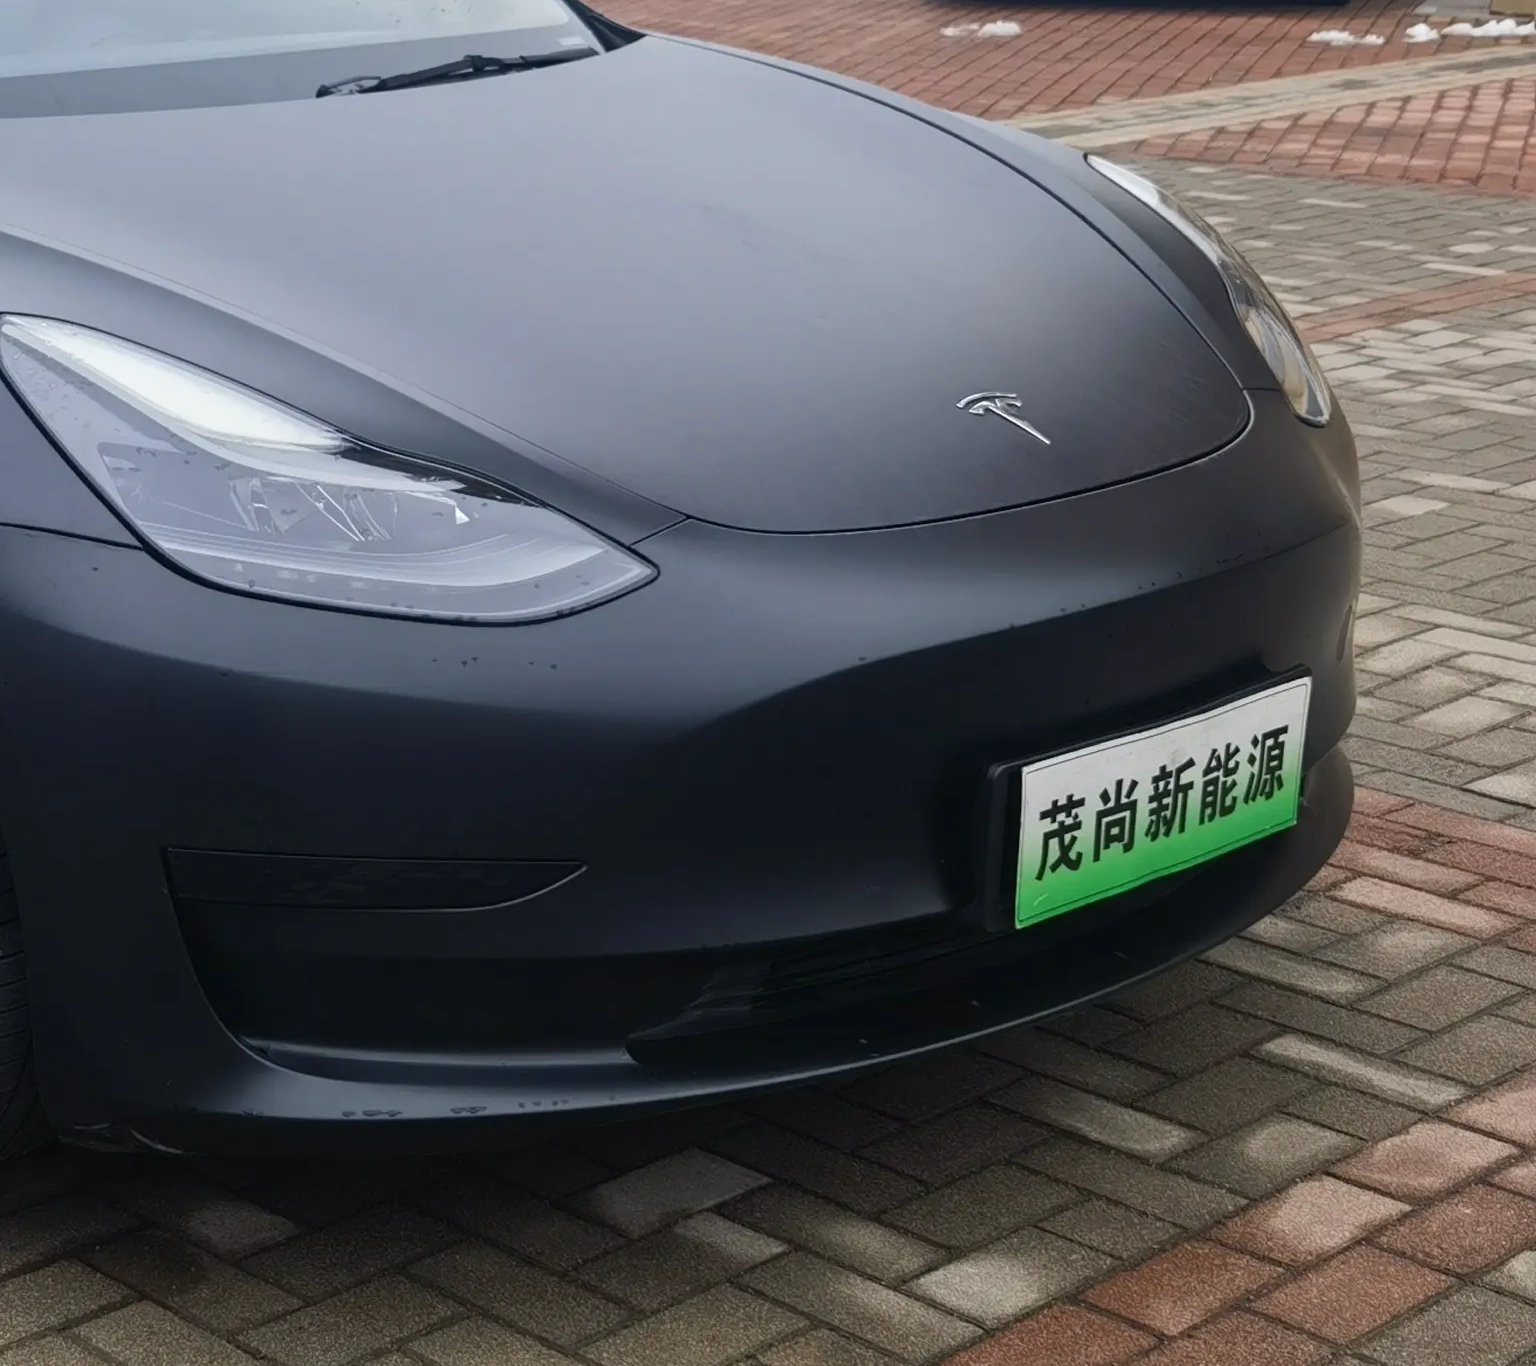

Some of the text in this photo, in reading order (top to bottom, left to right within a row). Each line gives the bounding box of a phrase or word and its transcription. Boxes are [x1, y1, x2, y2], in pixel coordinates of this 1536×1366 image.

[1035, 724, 1289, 881] 茂尚新能源
